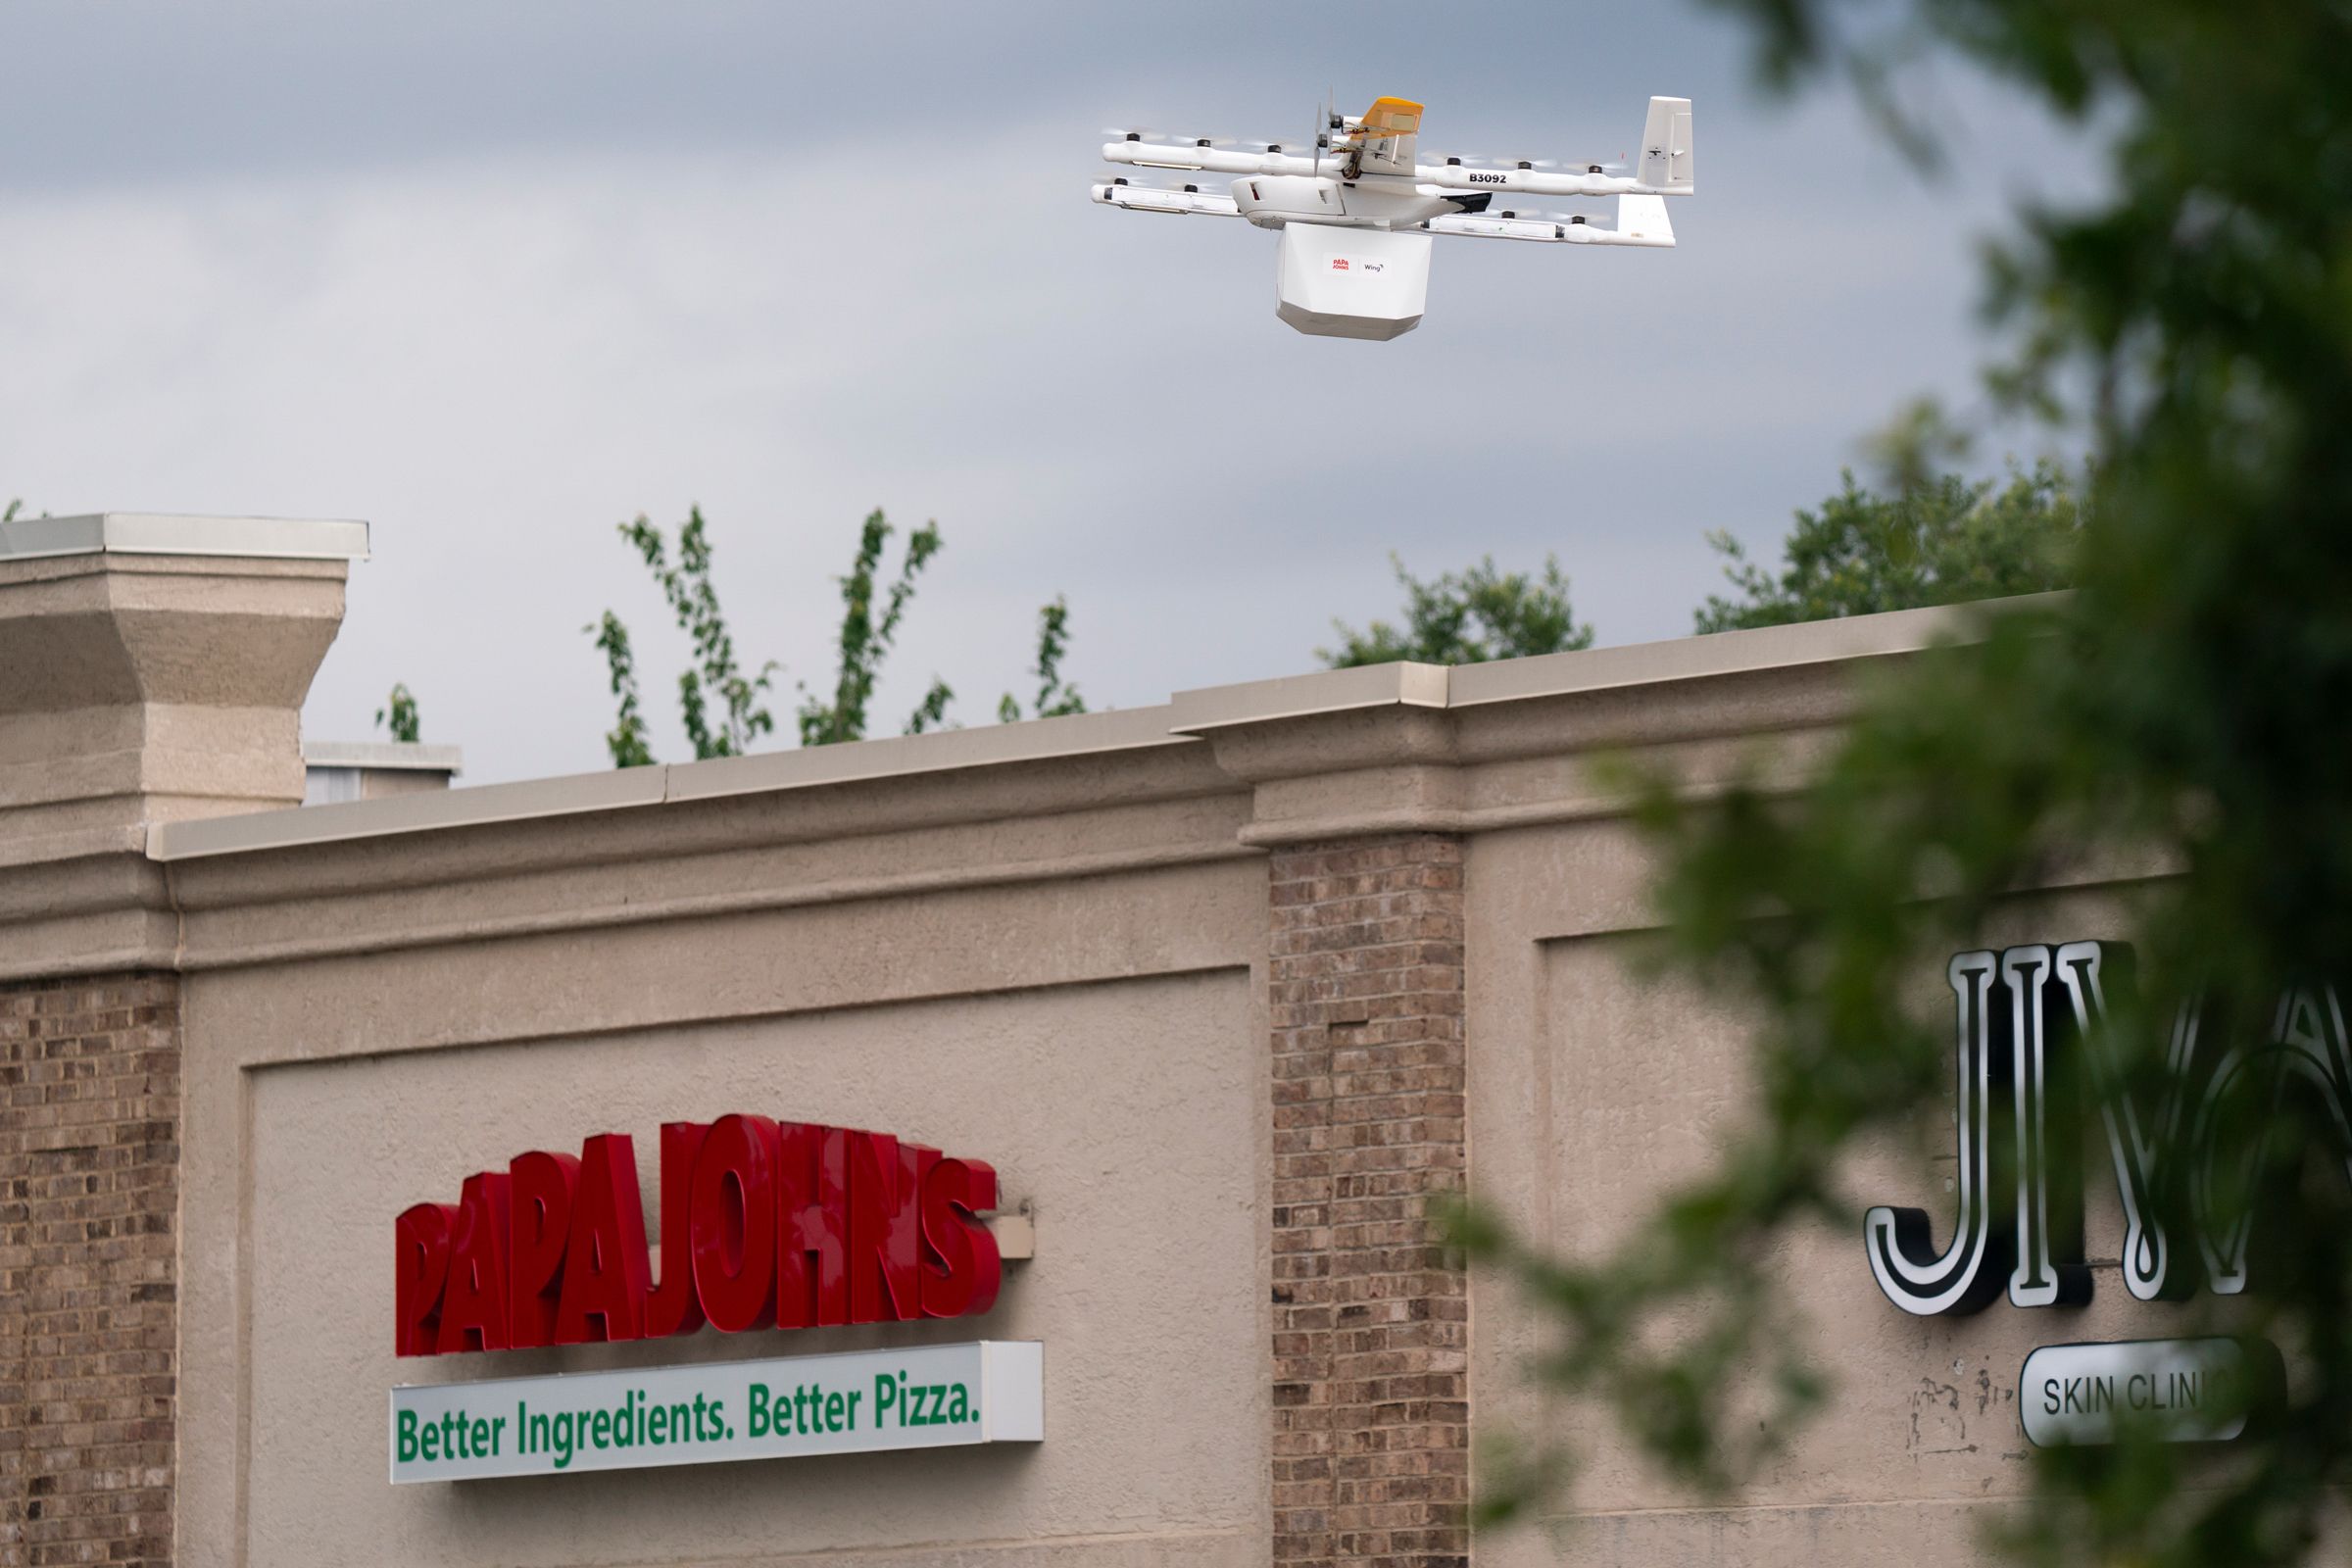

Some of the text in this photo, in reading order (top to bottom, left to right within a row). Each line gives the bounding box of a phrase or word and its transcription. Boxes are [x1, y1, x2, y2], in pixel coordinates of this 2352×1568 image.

[1469, 173, 1506, 183] B3092
[1364, 264, 1381, 272] Wing
[2043, 1375, 2114, 1415] SKIN
[397, 1369, 981, 1470] Better Ingredients. Better Pizza.
